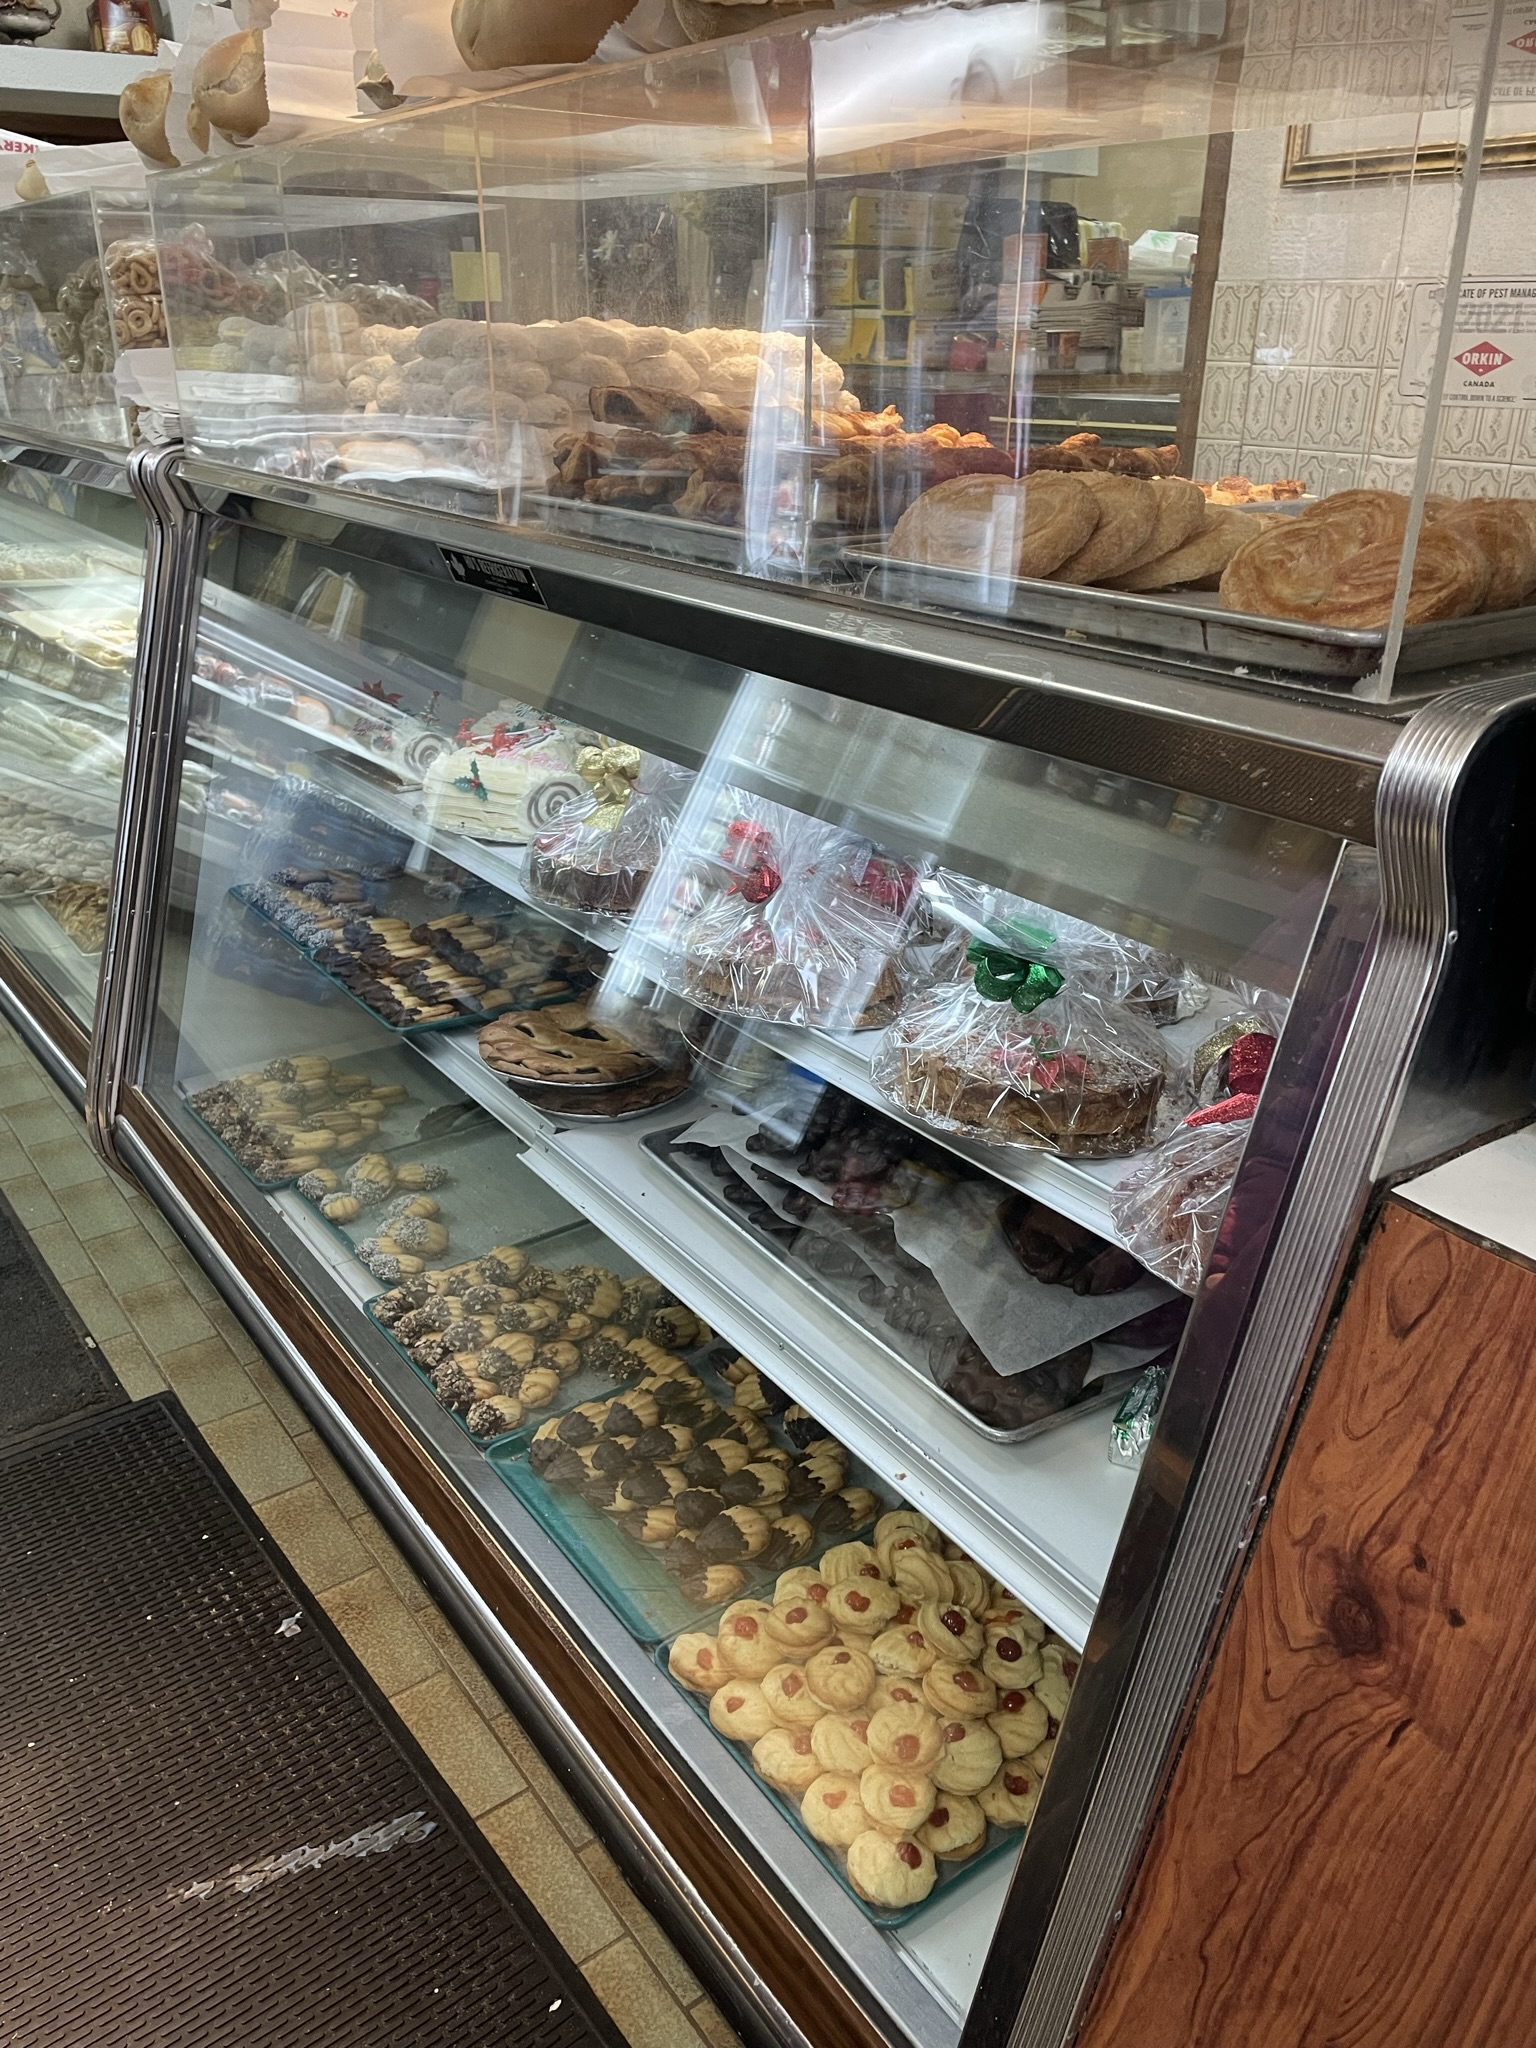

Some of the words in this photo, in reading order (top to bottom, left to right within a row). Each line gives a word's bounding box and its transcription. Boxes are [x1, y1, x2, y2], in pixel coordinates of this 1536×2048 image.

[1477, 288, 1487, 298] OF
[1489, 288, 1508, 298] PEST
[1462, 352, 1503, 365] ORKIN
